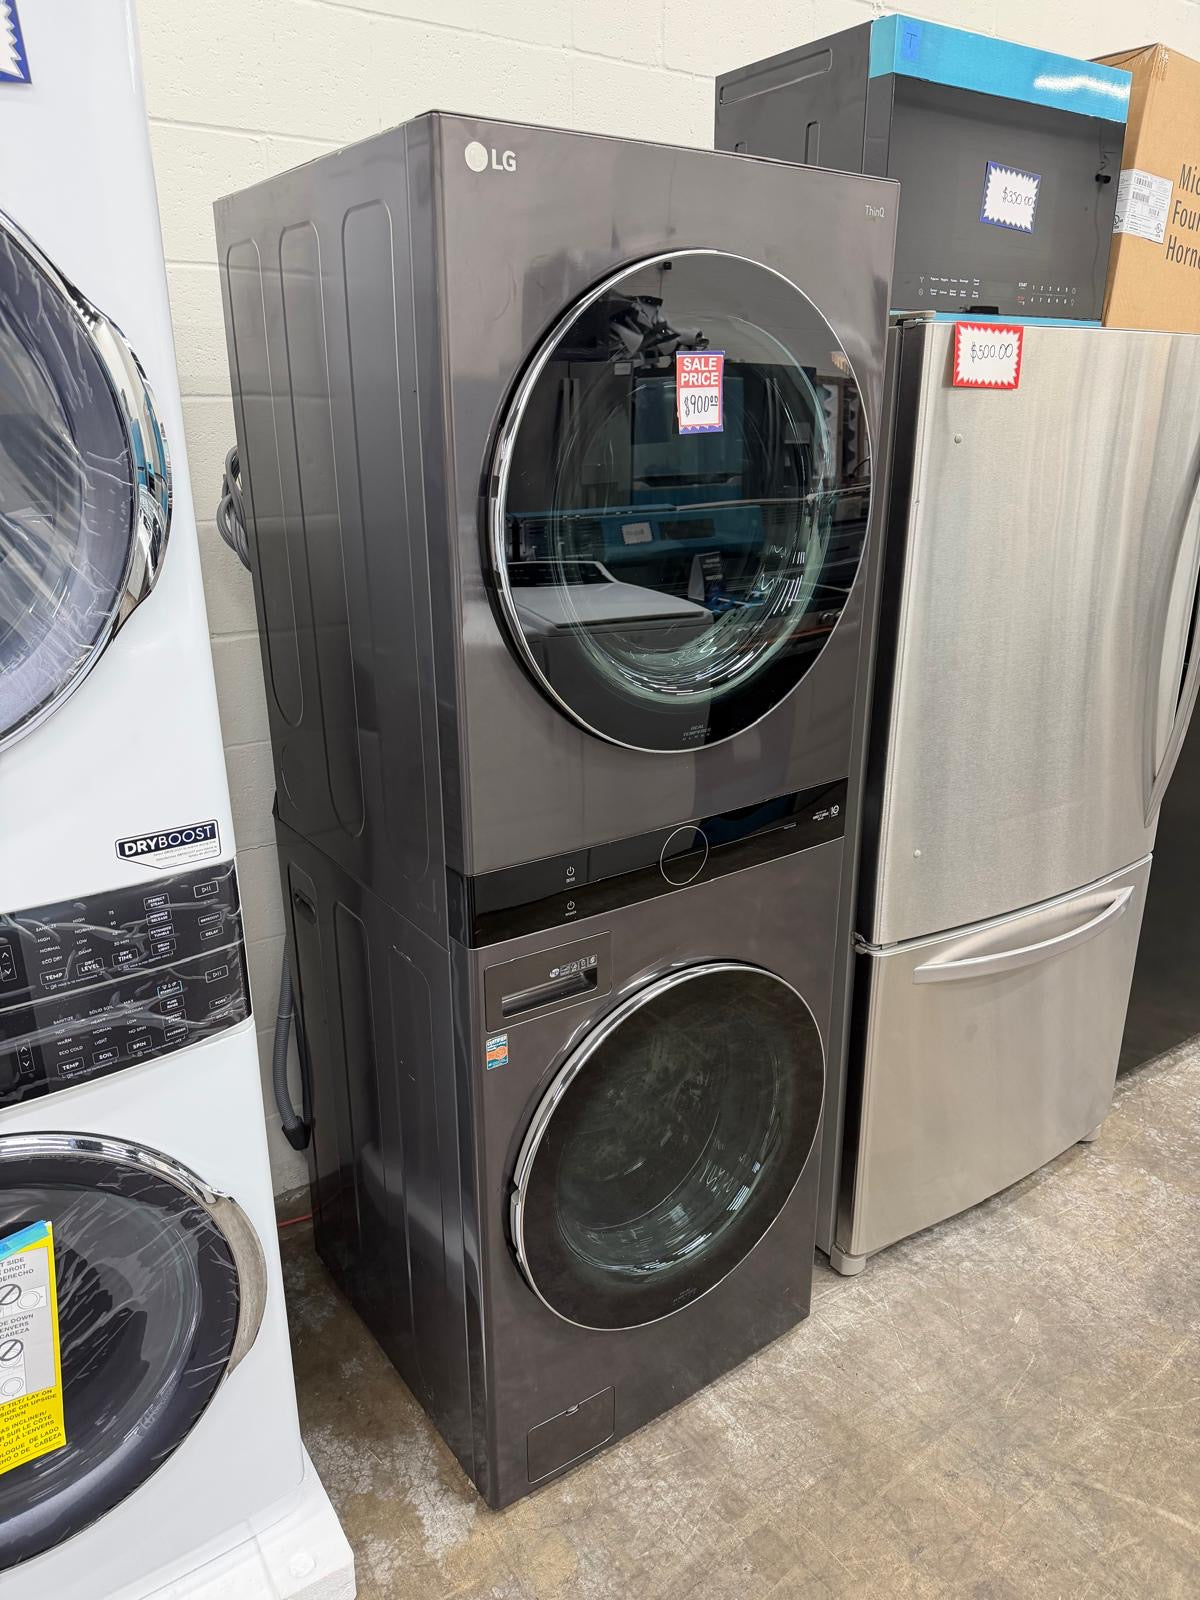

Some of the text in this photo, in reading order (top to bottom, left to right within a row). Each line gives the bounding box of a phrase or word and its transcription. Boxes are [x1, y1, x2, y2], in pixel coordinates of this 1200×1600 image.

[491, 148, 517, 172] LG
[865, 204, 885, 218] ThinQ
[970, 341, 1014, 364] $500.00
[683, 357, 718, 371] SALE
[681, 372, 719, 386] PRICE
[123, 825, 212, 856] DRYBOOST
[118, 953, 132, 962] TIME
[81, 963, 100, 972] LEVEL
[45, 972, 62, 981] TEMP
[132, 1041, 146, 1050] SPIN
[98, 1052, 112, 1060] SOIL
[62, 1062, 79, 1070] TEMP
[4, 1263, 26, 1274] DROIT
[10, 1313, 34, 1324] DOWN
[26, 1392, 40, 1401] LAY
[30, 1393, 56, 1406] UPSIDE
[4, 1410, 26, 1423] DOWN
[6, 1427, 21, 1438] SUR
[22, 1422, 32, 1430] LE
[29, 1436, 38, 1444] DE
[40, 1426, 60, 1438] LADO
[4, 1438, 14, 1447] OU
[20, 1446, 30, 1455] DE
[34, 1432, 62, 1448] CABEZA
